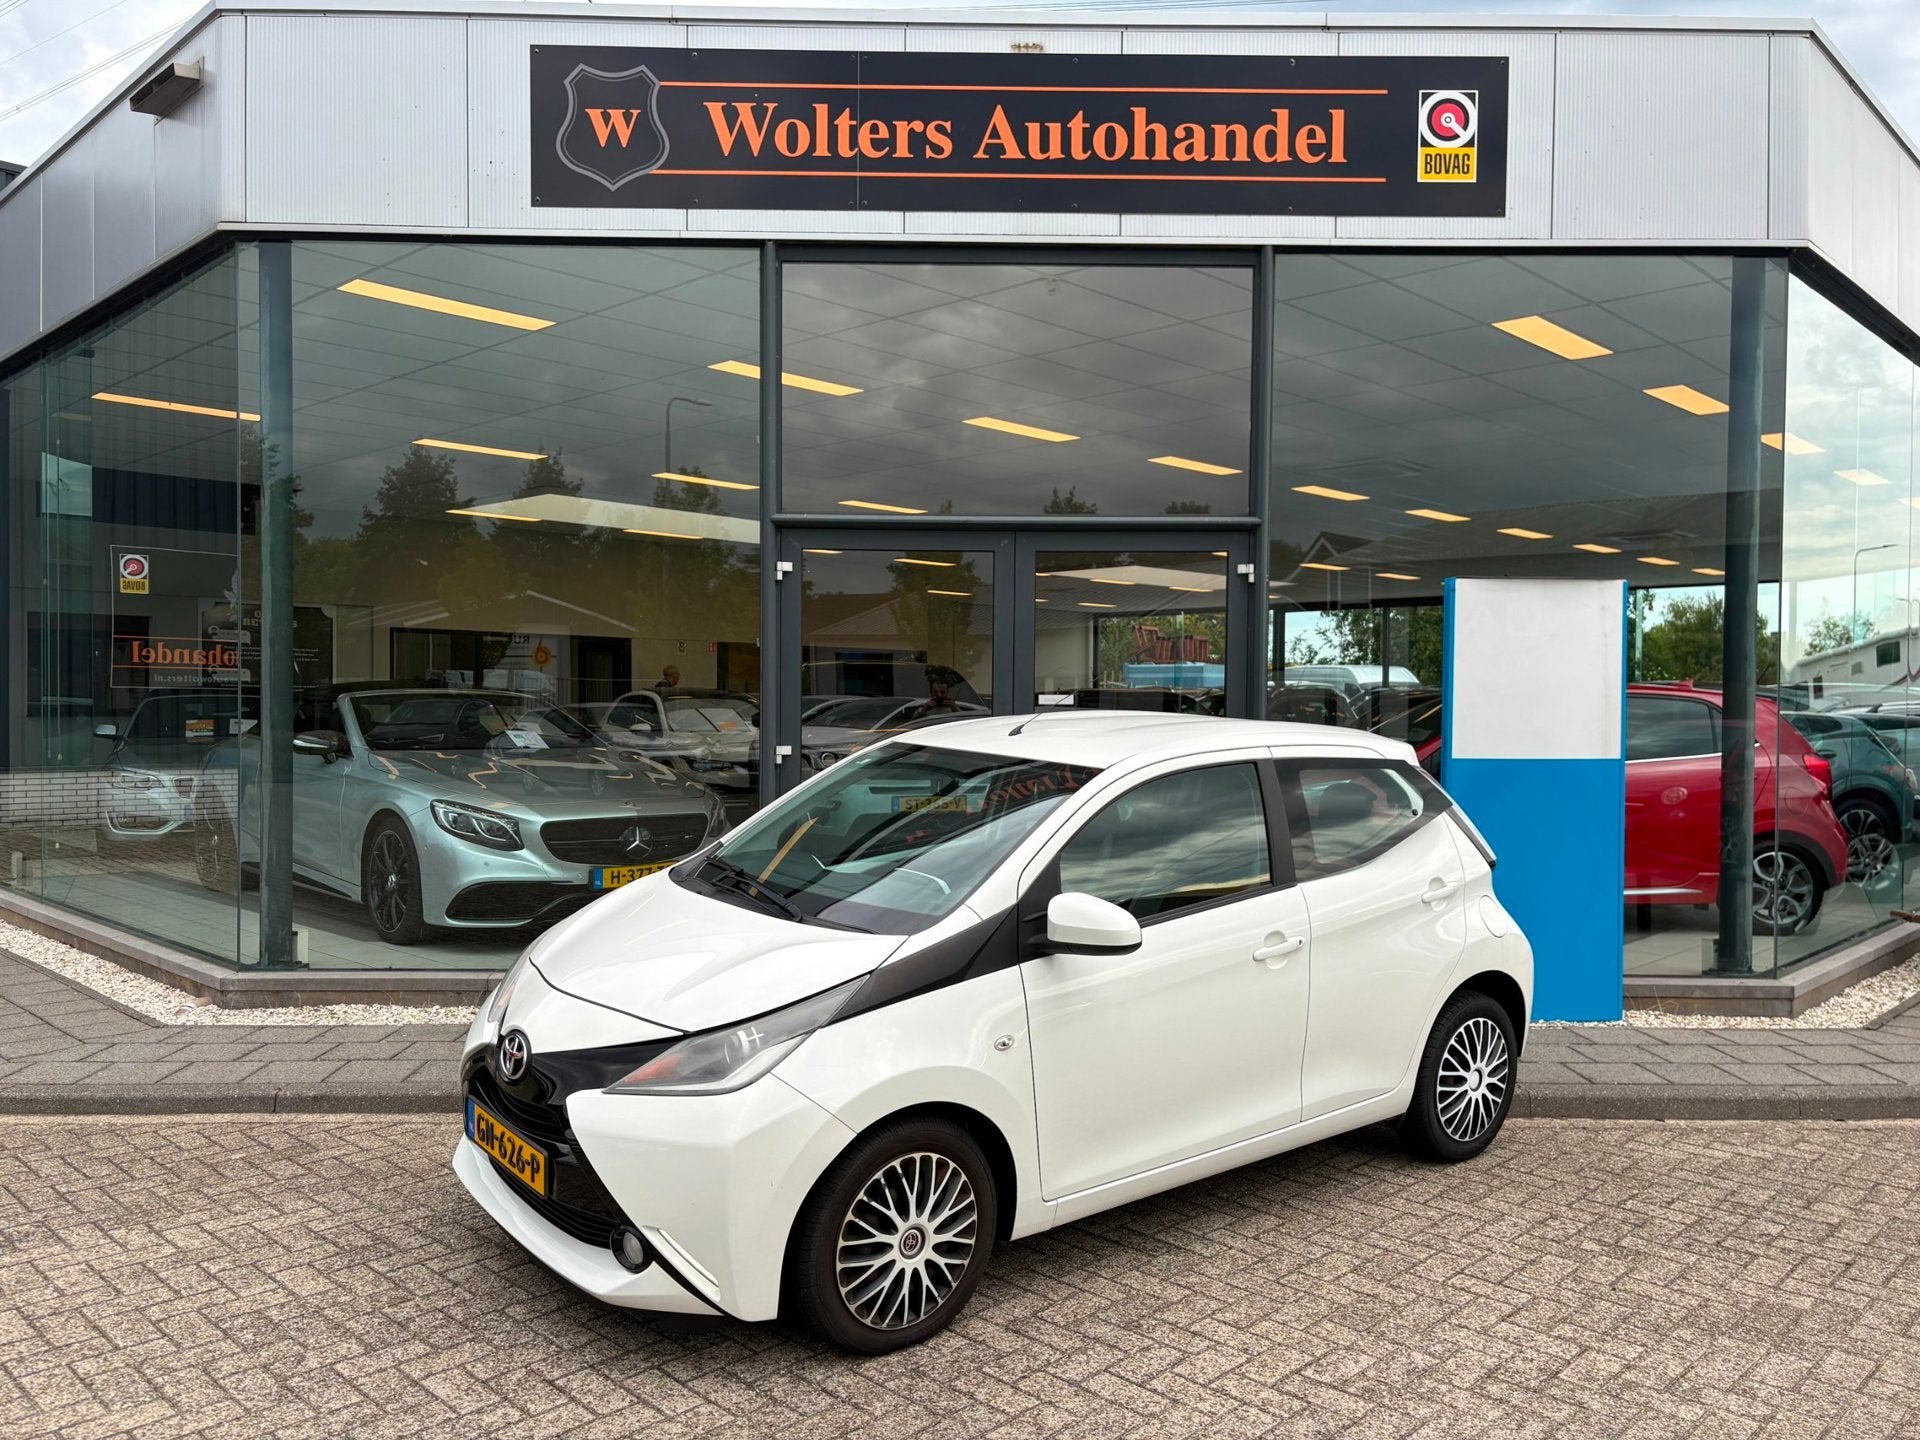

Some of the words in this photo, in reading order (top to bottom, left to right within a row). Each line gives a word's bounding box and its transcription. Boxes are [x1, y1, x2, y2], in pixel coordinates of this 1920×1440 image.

[584, 108, 641, 148] W
[703, 101, 953, 160] Wolters
[972, 104, 1347, 163] Autohandel
[1423, 152, 1471, 175] BOVAG
[477, 1112, 540, 1183] GN-626-P
